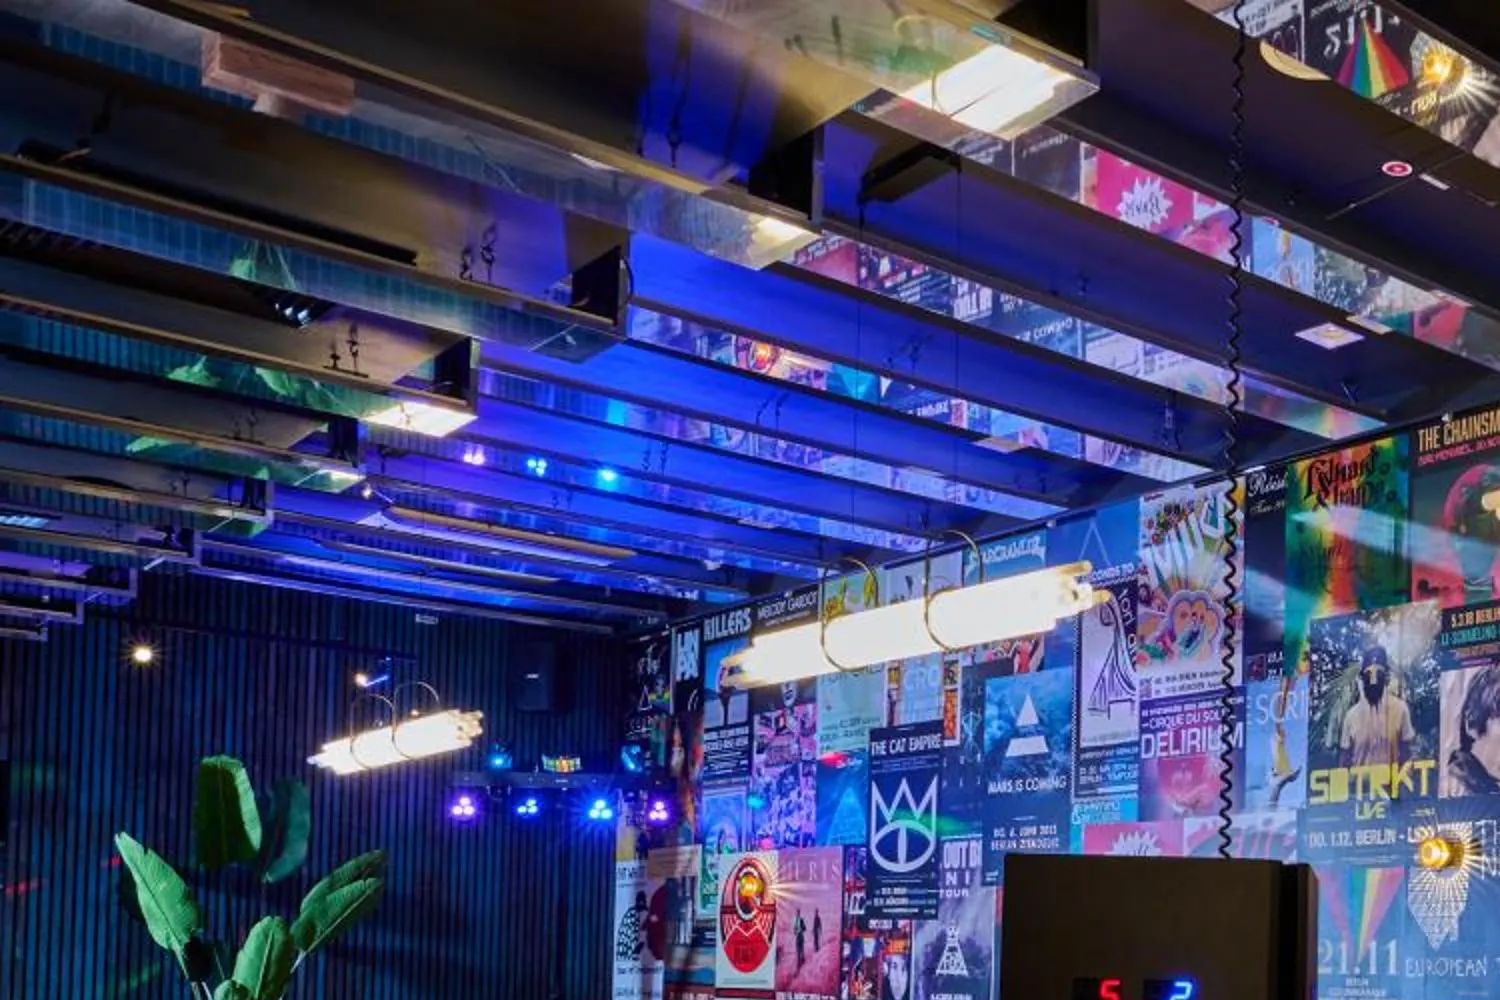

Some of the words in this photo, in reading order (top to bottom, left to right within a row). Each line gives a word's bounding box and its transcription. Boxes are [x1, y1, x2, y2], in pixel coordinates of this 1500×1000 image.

[1418, 425, 1441, 452] THE
[872, 741, 887, 757] THE
[889, 740, 907, 753] CAT
[909, 735, 942, 753] EMPIRE
[1141, 721, 1243, 759] DELIRIUM
[1025, 776, 1067, 792] COMING
[1356, 801, 1386, 820] LIVE
[1355, 828, 1397, 846] BERLIN
[1406, 956, 1487, 977] EUROPEAN
